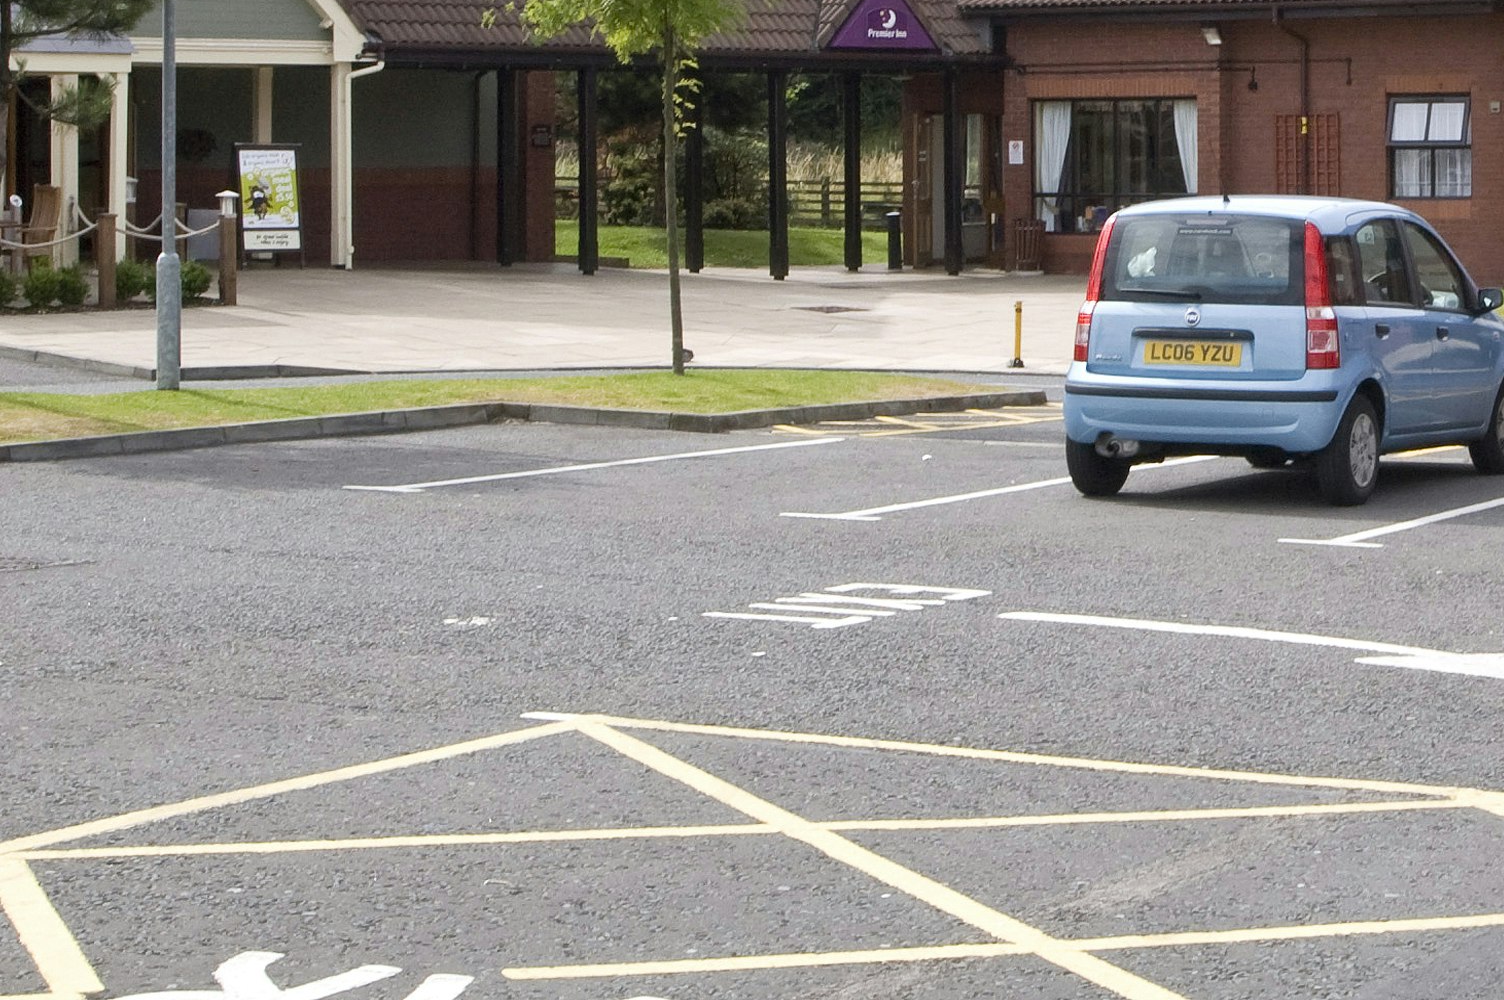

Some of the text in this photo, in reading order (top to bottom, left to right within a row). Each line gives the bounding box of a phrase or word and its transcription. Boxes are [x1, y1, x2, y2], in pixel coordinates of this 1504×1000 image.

[867, 28, 908, 39] Premier Inn
[1151, 343, 1235, 363] LC06 YZU
